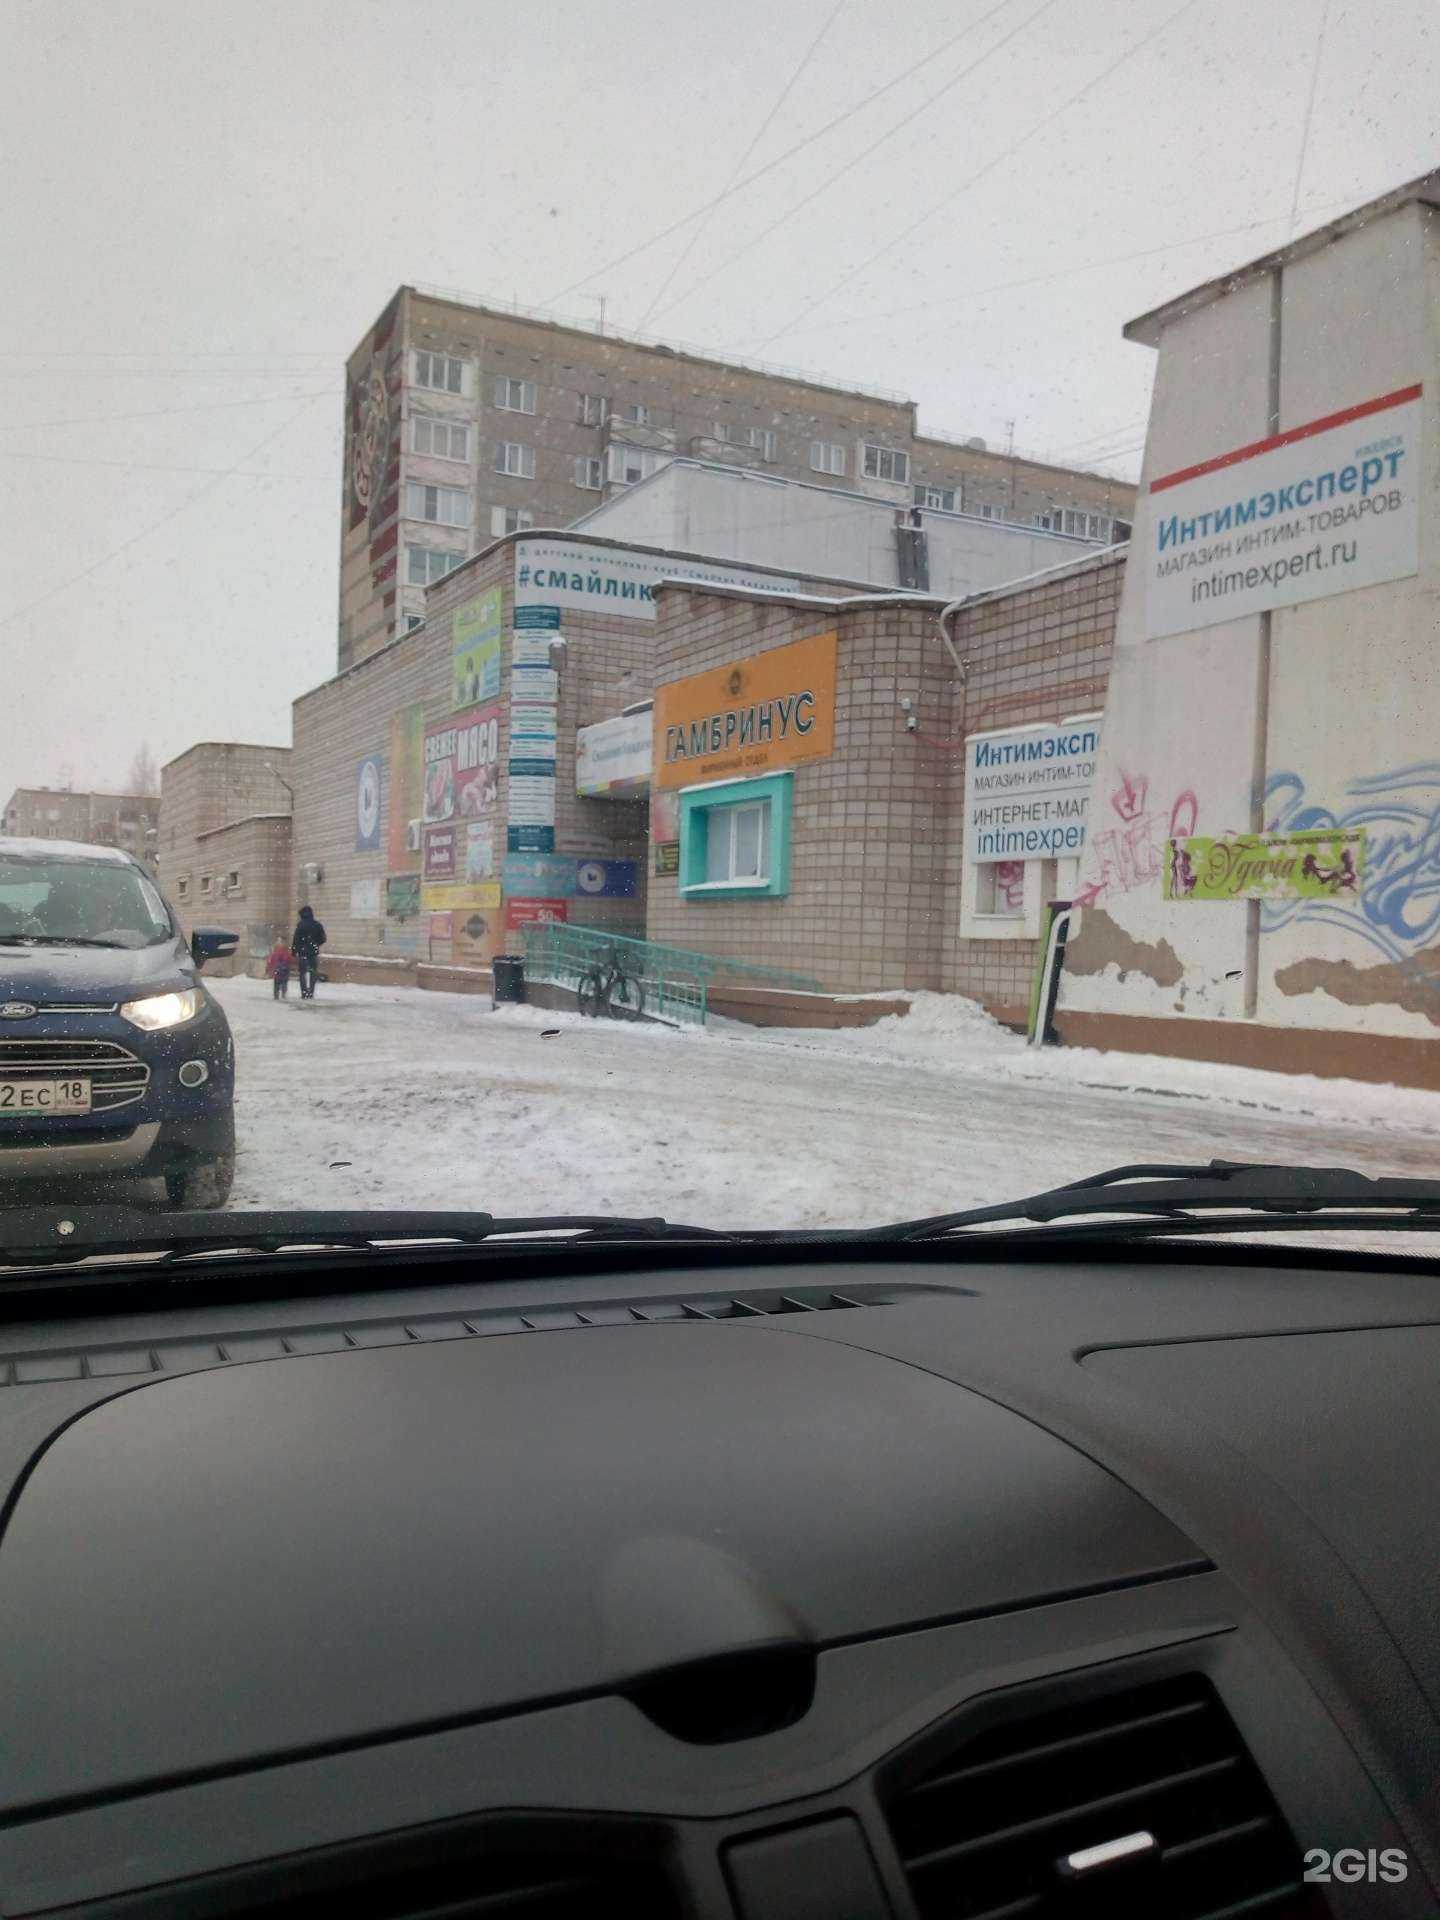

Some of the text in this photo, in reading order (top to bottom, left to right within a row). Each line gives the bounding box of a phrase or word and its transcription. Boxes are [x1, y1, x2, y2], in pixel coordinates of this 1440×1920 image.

[1158, 449, 1405, 552] Интимэксперт
[1156, 490, 1402, 578] МАГАЗИН ИНТИМ-ТОВАРОВ
[518, 565, 652, 601] #смайлик
[1191, 540, 1358, 602] intimexpert.ru
[664, 690, 815, 764] ГАМБРИНУС
[975, 732, 1100, 768] Интимэксп
[974, 771, 1026, 792] МАГАЗИН
[60, 1082, 82, 1098] 18
